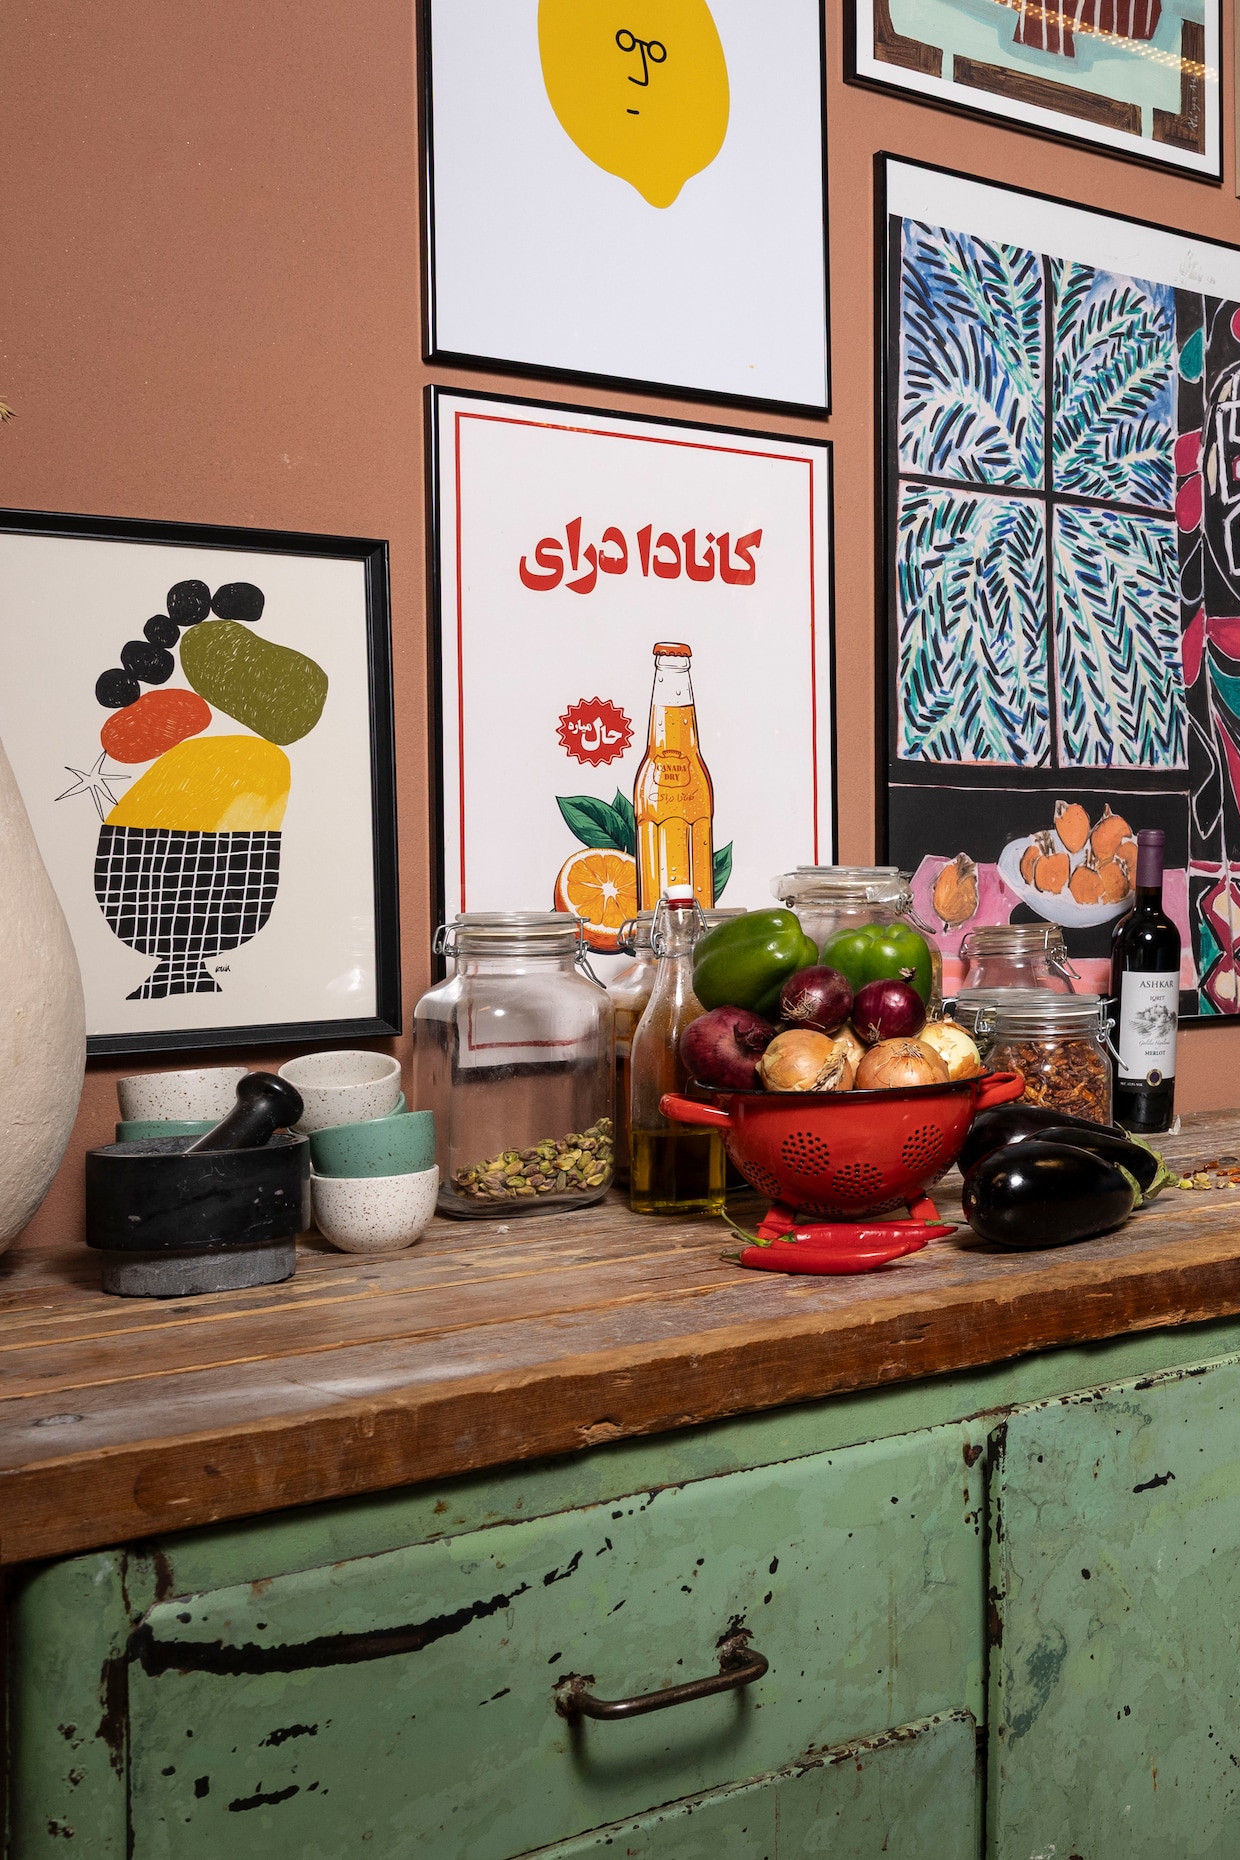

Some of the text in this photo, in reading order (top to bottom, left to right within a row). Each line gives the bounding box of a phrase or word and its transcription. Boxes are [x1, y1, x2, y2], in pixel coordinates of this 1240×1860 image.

[519, 516, 763, 595] کانادا درای
[581, 716, 623, 751] حال
[657, 764, 687, 773] CANADA
[664, 773, 680, 781] DRY
[1139, 980, 1174, 989] ASHKAR
